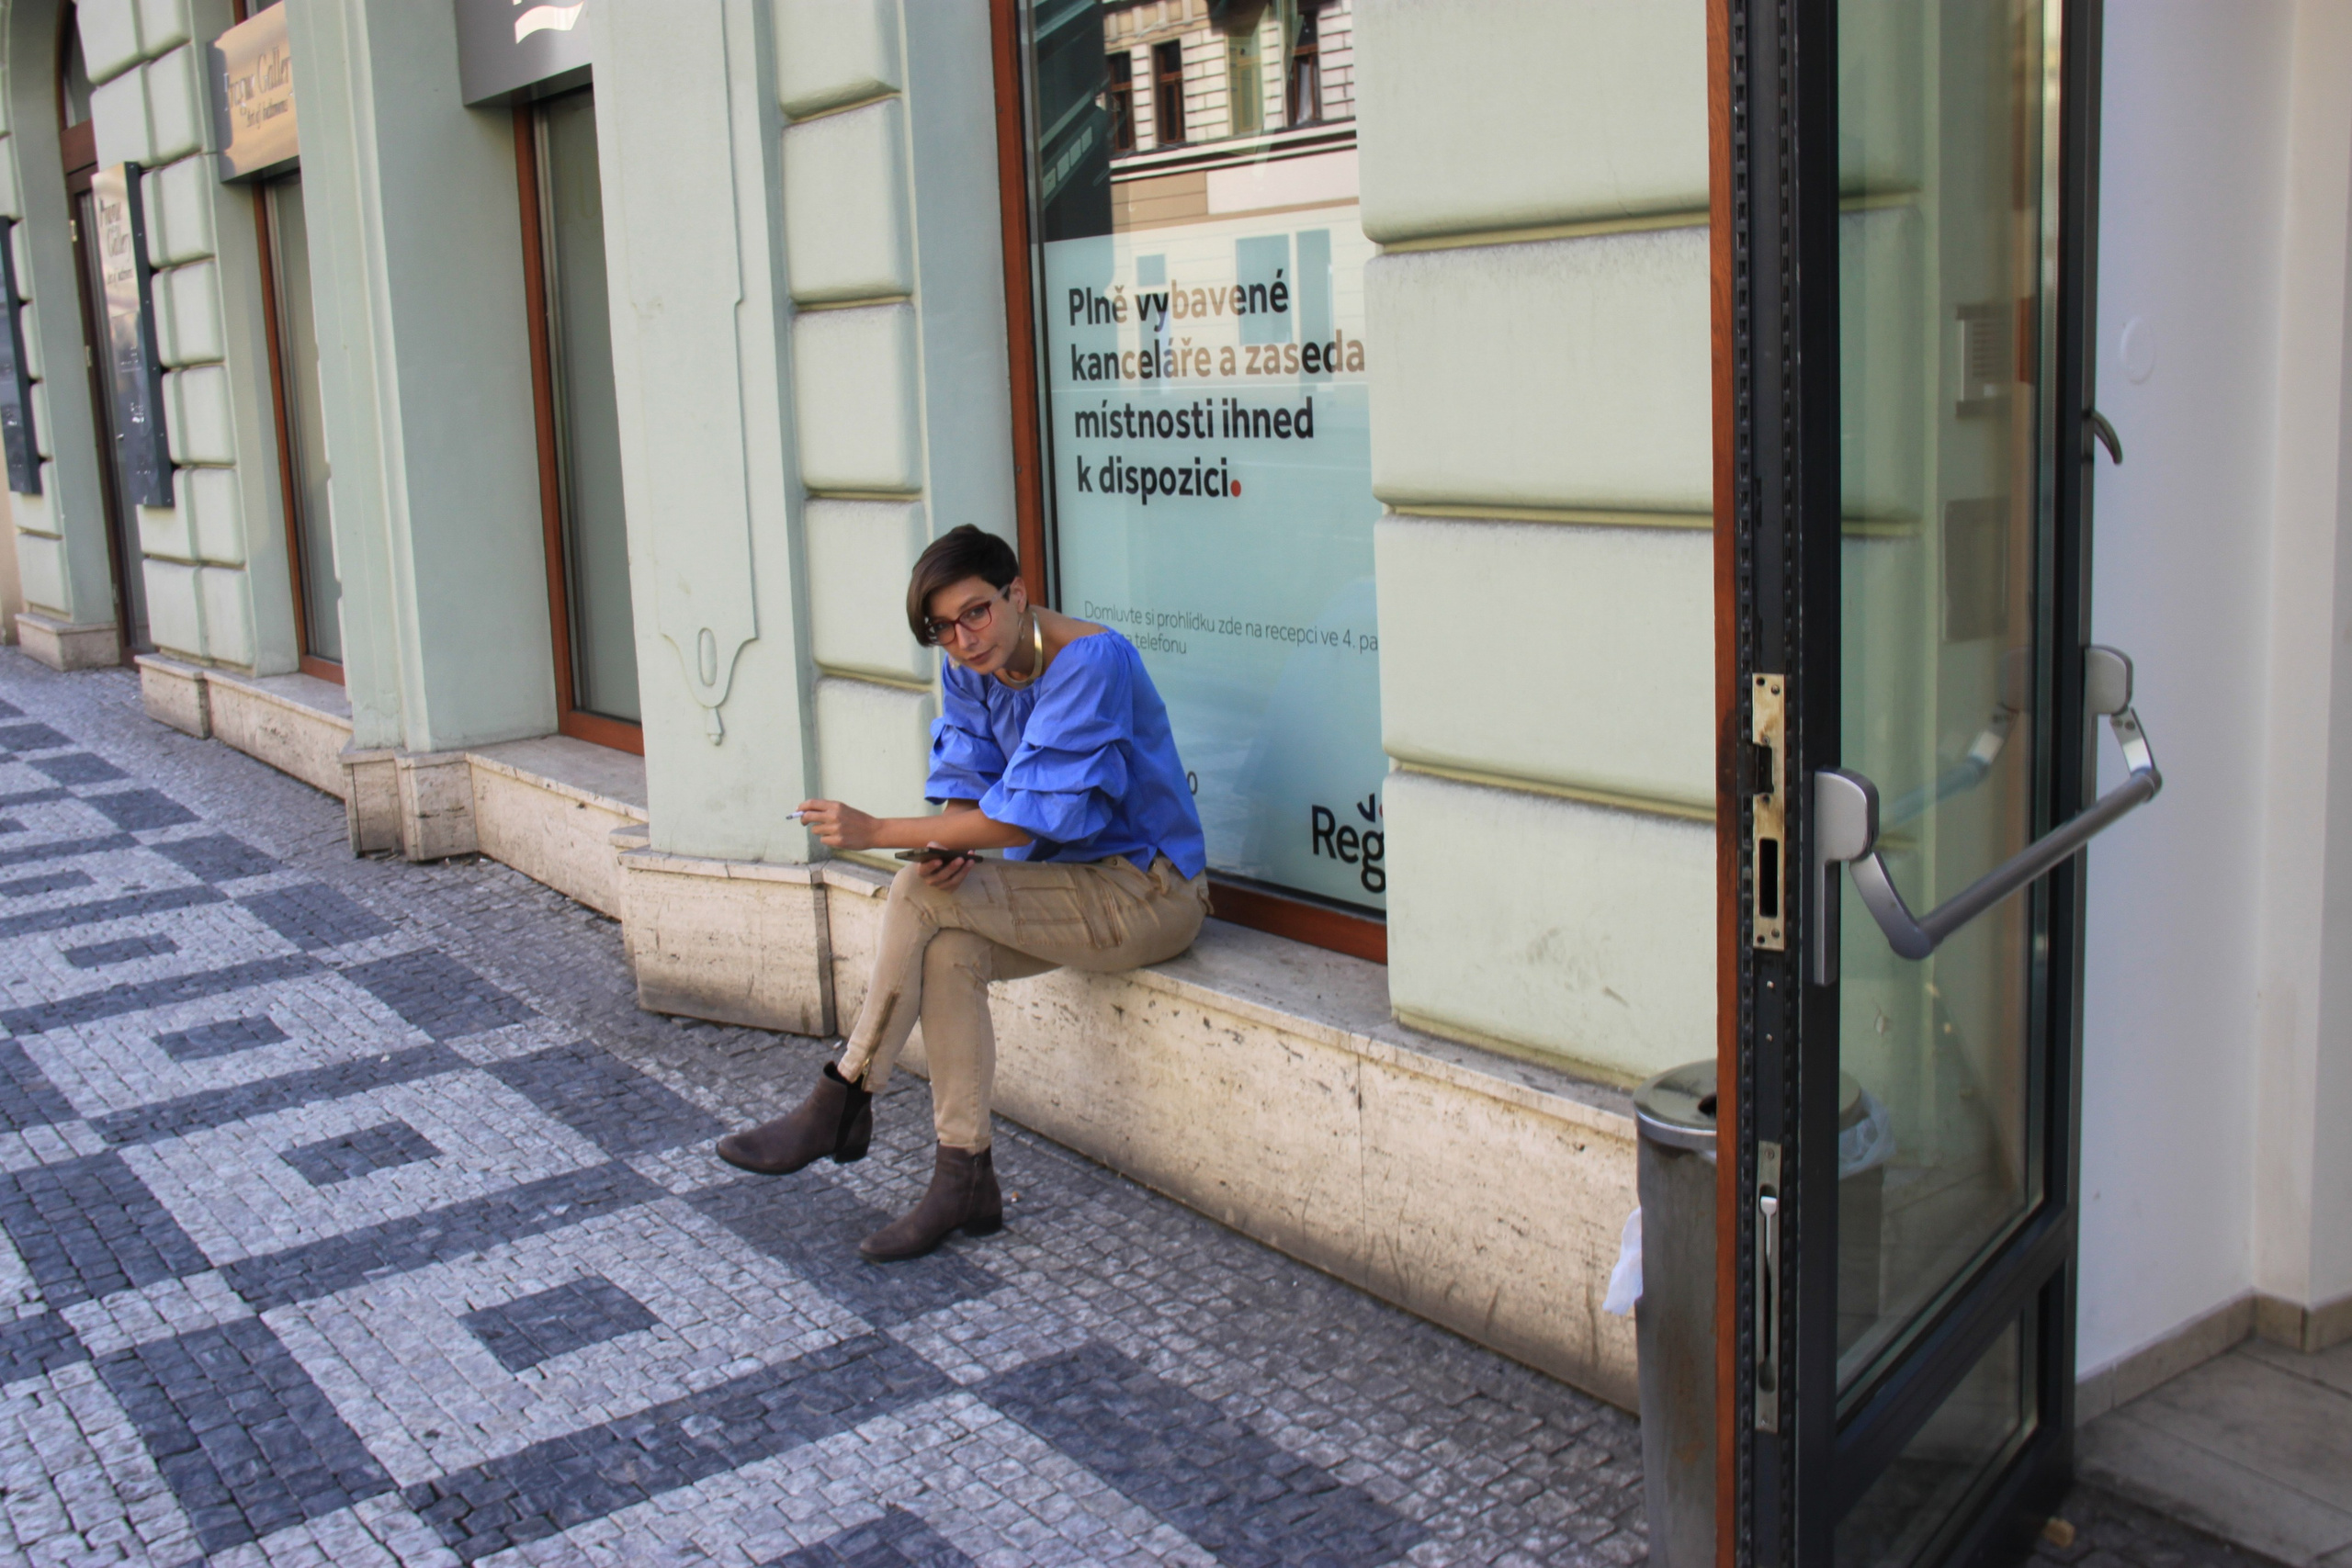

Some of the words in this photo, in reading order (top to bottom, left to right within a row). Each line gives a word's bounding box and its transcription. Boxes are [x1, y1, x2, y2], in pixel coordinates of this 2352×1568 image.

[257, 46, 293, 97] Galler
[1069, 285, 1127, 326] Plně
[1135, 268, 1289, 333] vybavené
[1071, 337, 1212, 381] kanceláře
[1219, 345, 1237, 376] a
[1245, 329, 1365, 375] zaseda
[1075, 398, 1214, 439] místnosti
[1222, 396, 1314, 439] ihned
[1077, 456, 1093, 492] k
[1099, 456, 1242, 506] dispozici.
[1084, 600, 1143, 625] Domluvte
[1145, 608, 1155, 626] si
[1157, 610, 1215, 632] prohlídku
[1218, 616, 1242, 636] zde
[1245, 622, 1262, 637] na
[1265, 624, 1317, 647] recepci
[1320, 628, 1339, 646] ve
[1342, 628, 1356, 649] 4.
[1360, 633, 1379, 654] pa
[1135, 632, 1187, 654] telefonu
[1311, 804, 1386, 895] Reg
